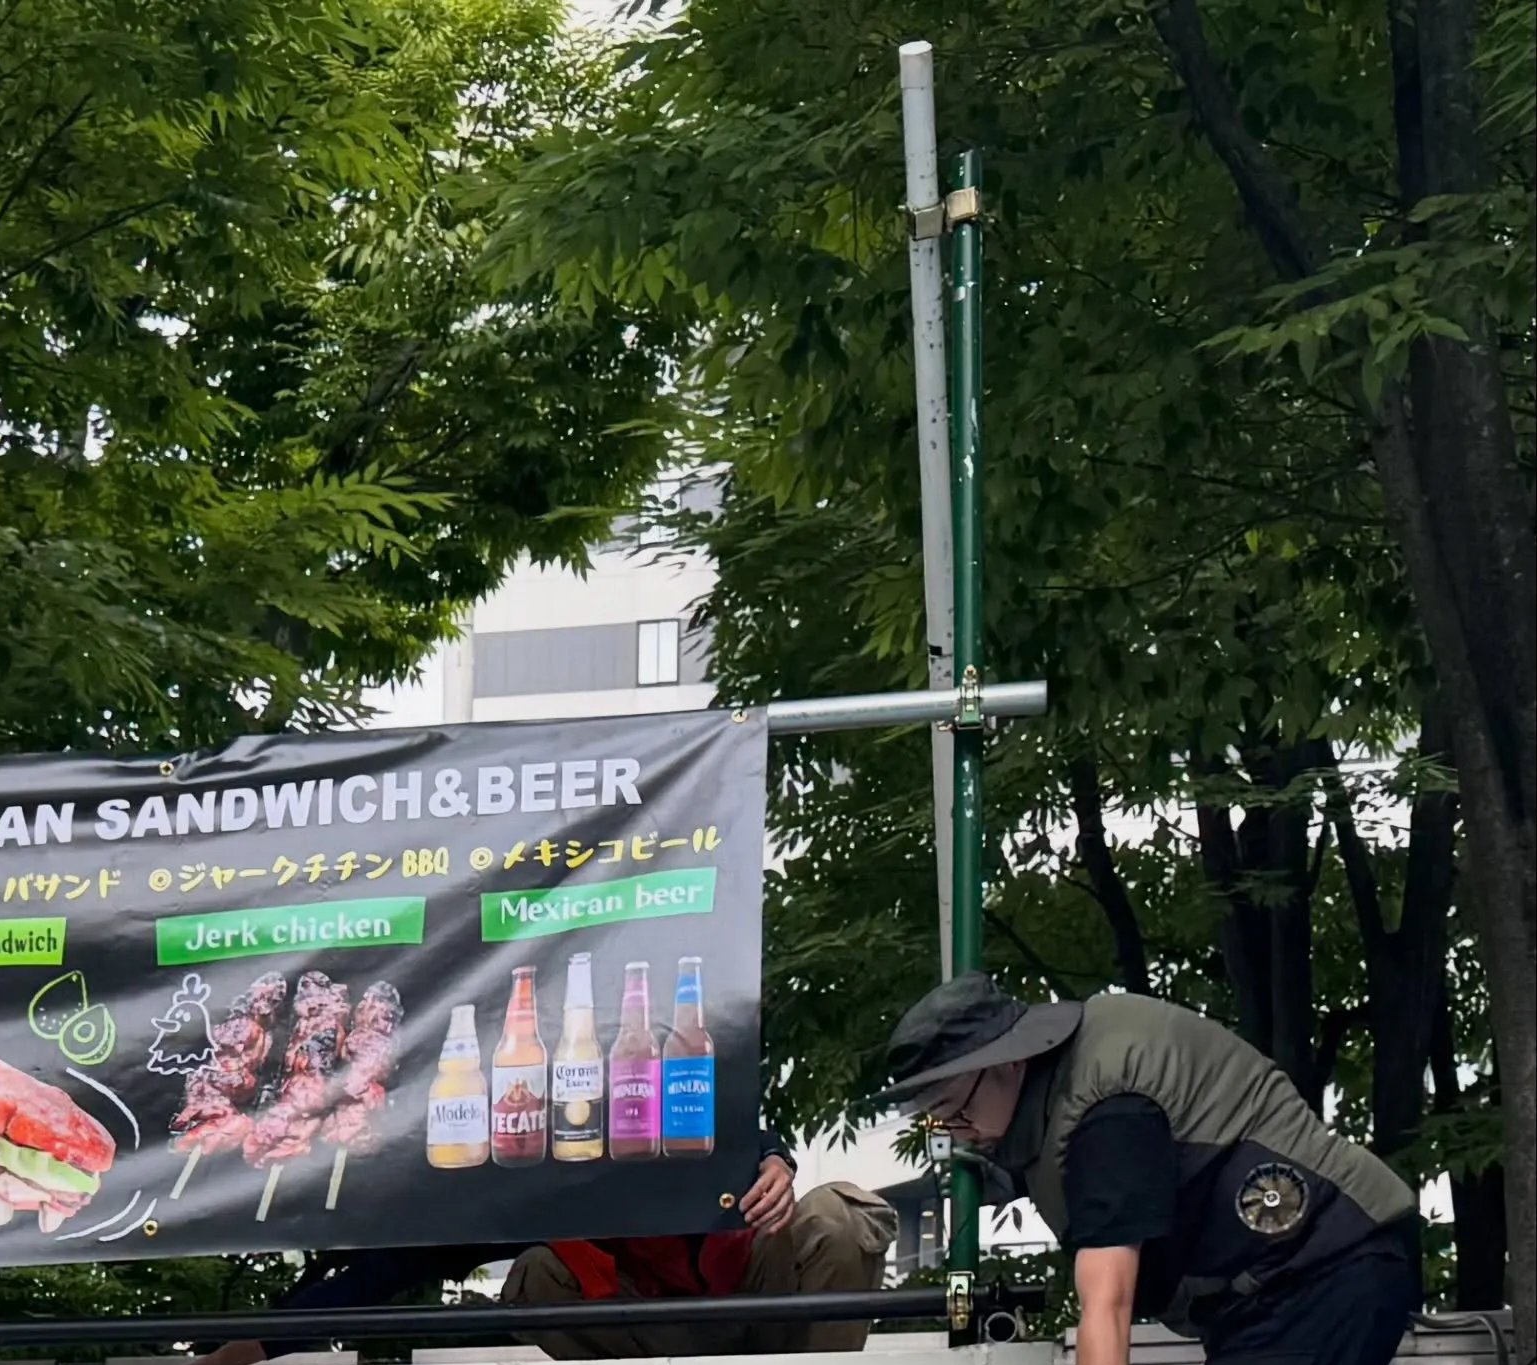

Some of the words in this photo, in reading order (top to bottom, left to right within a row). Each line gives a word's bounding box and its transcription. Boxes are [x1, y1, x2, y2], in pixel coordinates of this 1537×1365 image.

[94, 757, 643, 841] SANDWICH&BEER
[401, 846, 451, 880] BBQ
[502, 825, 723, 870] メキシコビール
[500, 893, 623, 926] Mexican
[636, 881, 704, 909] beer
[185, 920, 259, 951] Jerk
[272, 914, 392, 945] chicken
[494, 1110, 547, 1134] TECATE
